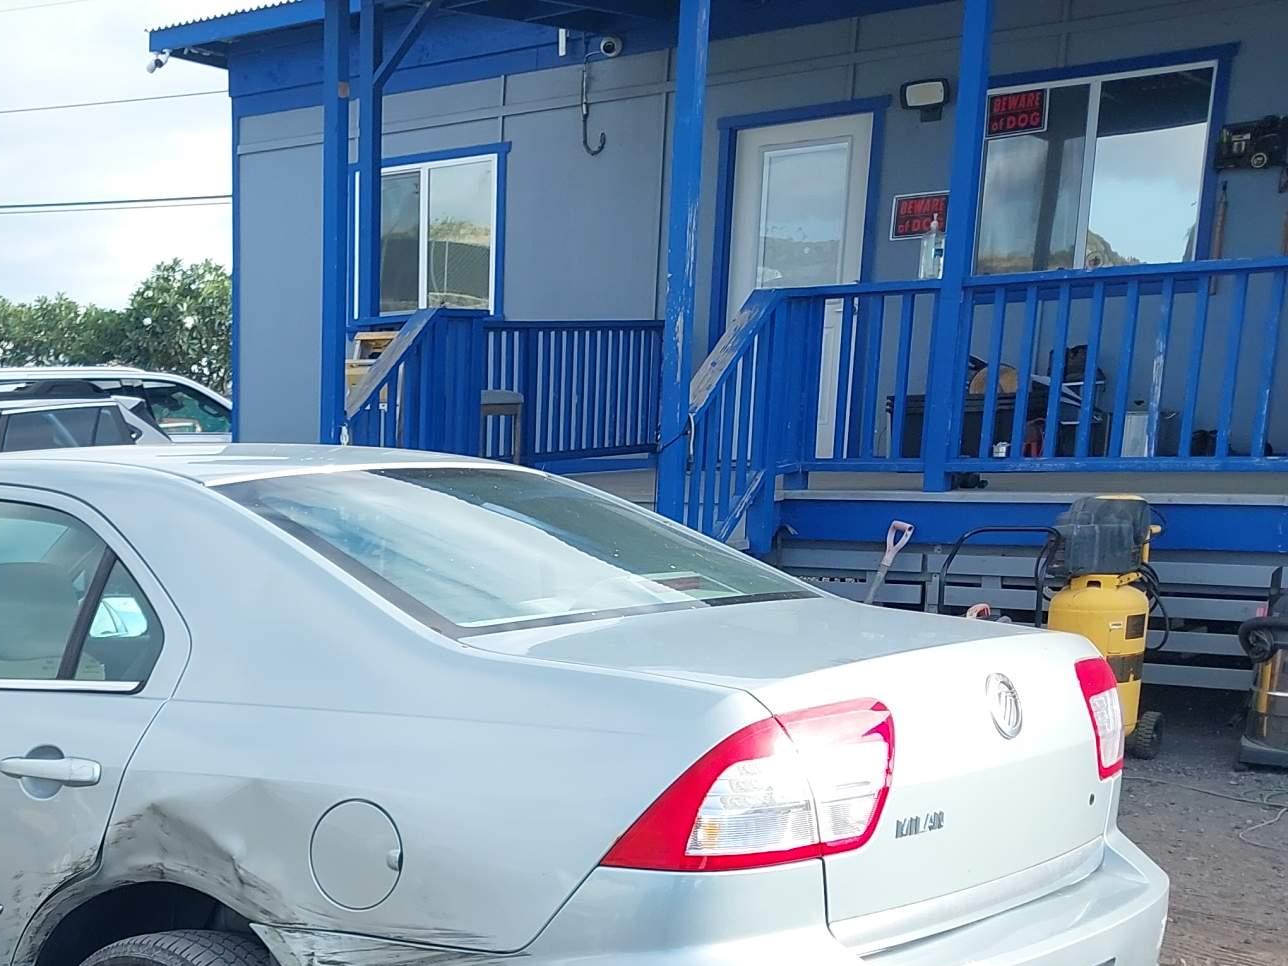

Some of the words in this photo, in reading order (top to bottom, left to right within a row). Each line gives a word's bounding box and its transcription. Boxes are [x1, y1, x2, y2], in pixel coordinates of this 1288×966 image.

[993, 92, 1041, 112] BEWARE
[992, 118, 1005, 131] of
[1006, 112, 1041, 129] DOG
[900, 197, 946, 215] BEWARE
[897, 220, 910, 233] of
